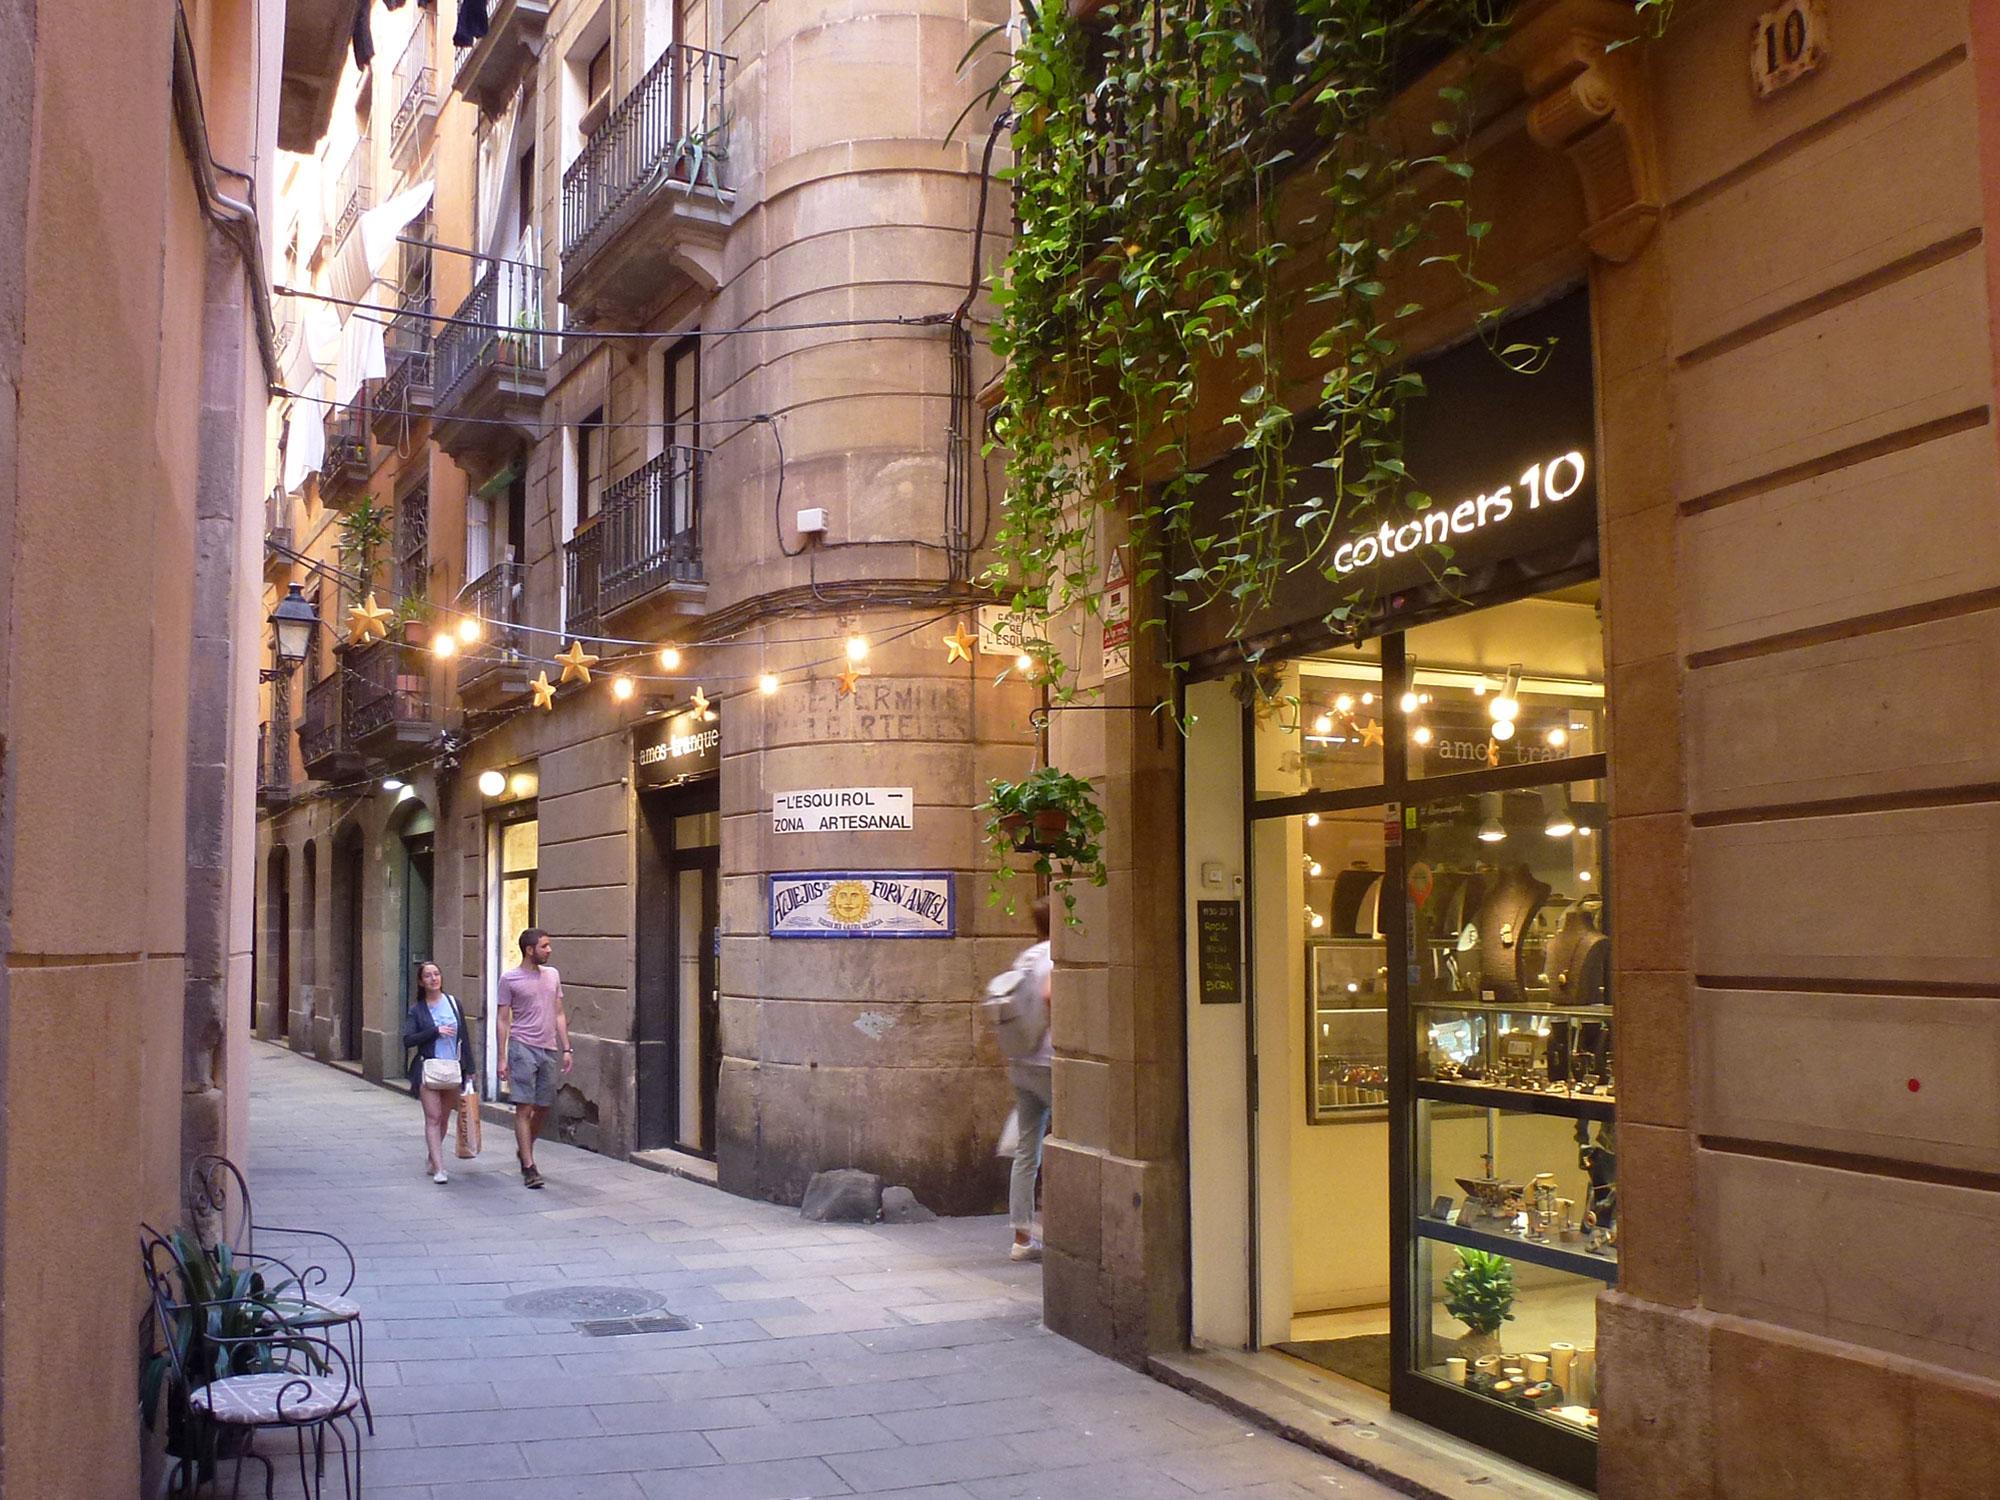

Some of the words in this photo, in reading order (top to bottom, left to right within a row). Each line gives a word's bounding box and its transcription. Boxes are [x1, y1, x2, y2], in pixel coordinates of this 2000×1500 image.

[1764, 9, 1806, 74] 10
[1334, 485, 1513, 573] cotoners
[1520, 451, 1585, 509] 10
[1439, 739, 1498, 762] amo
[786, 792, 875, 809] L'ESQUIROL
[774, 817, 805, 832] ZONA
[819, 814, 911, 831] ARTESANAL
[870, 880, 910, 905] FORN
